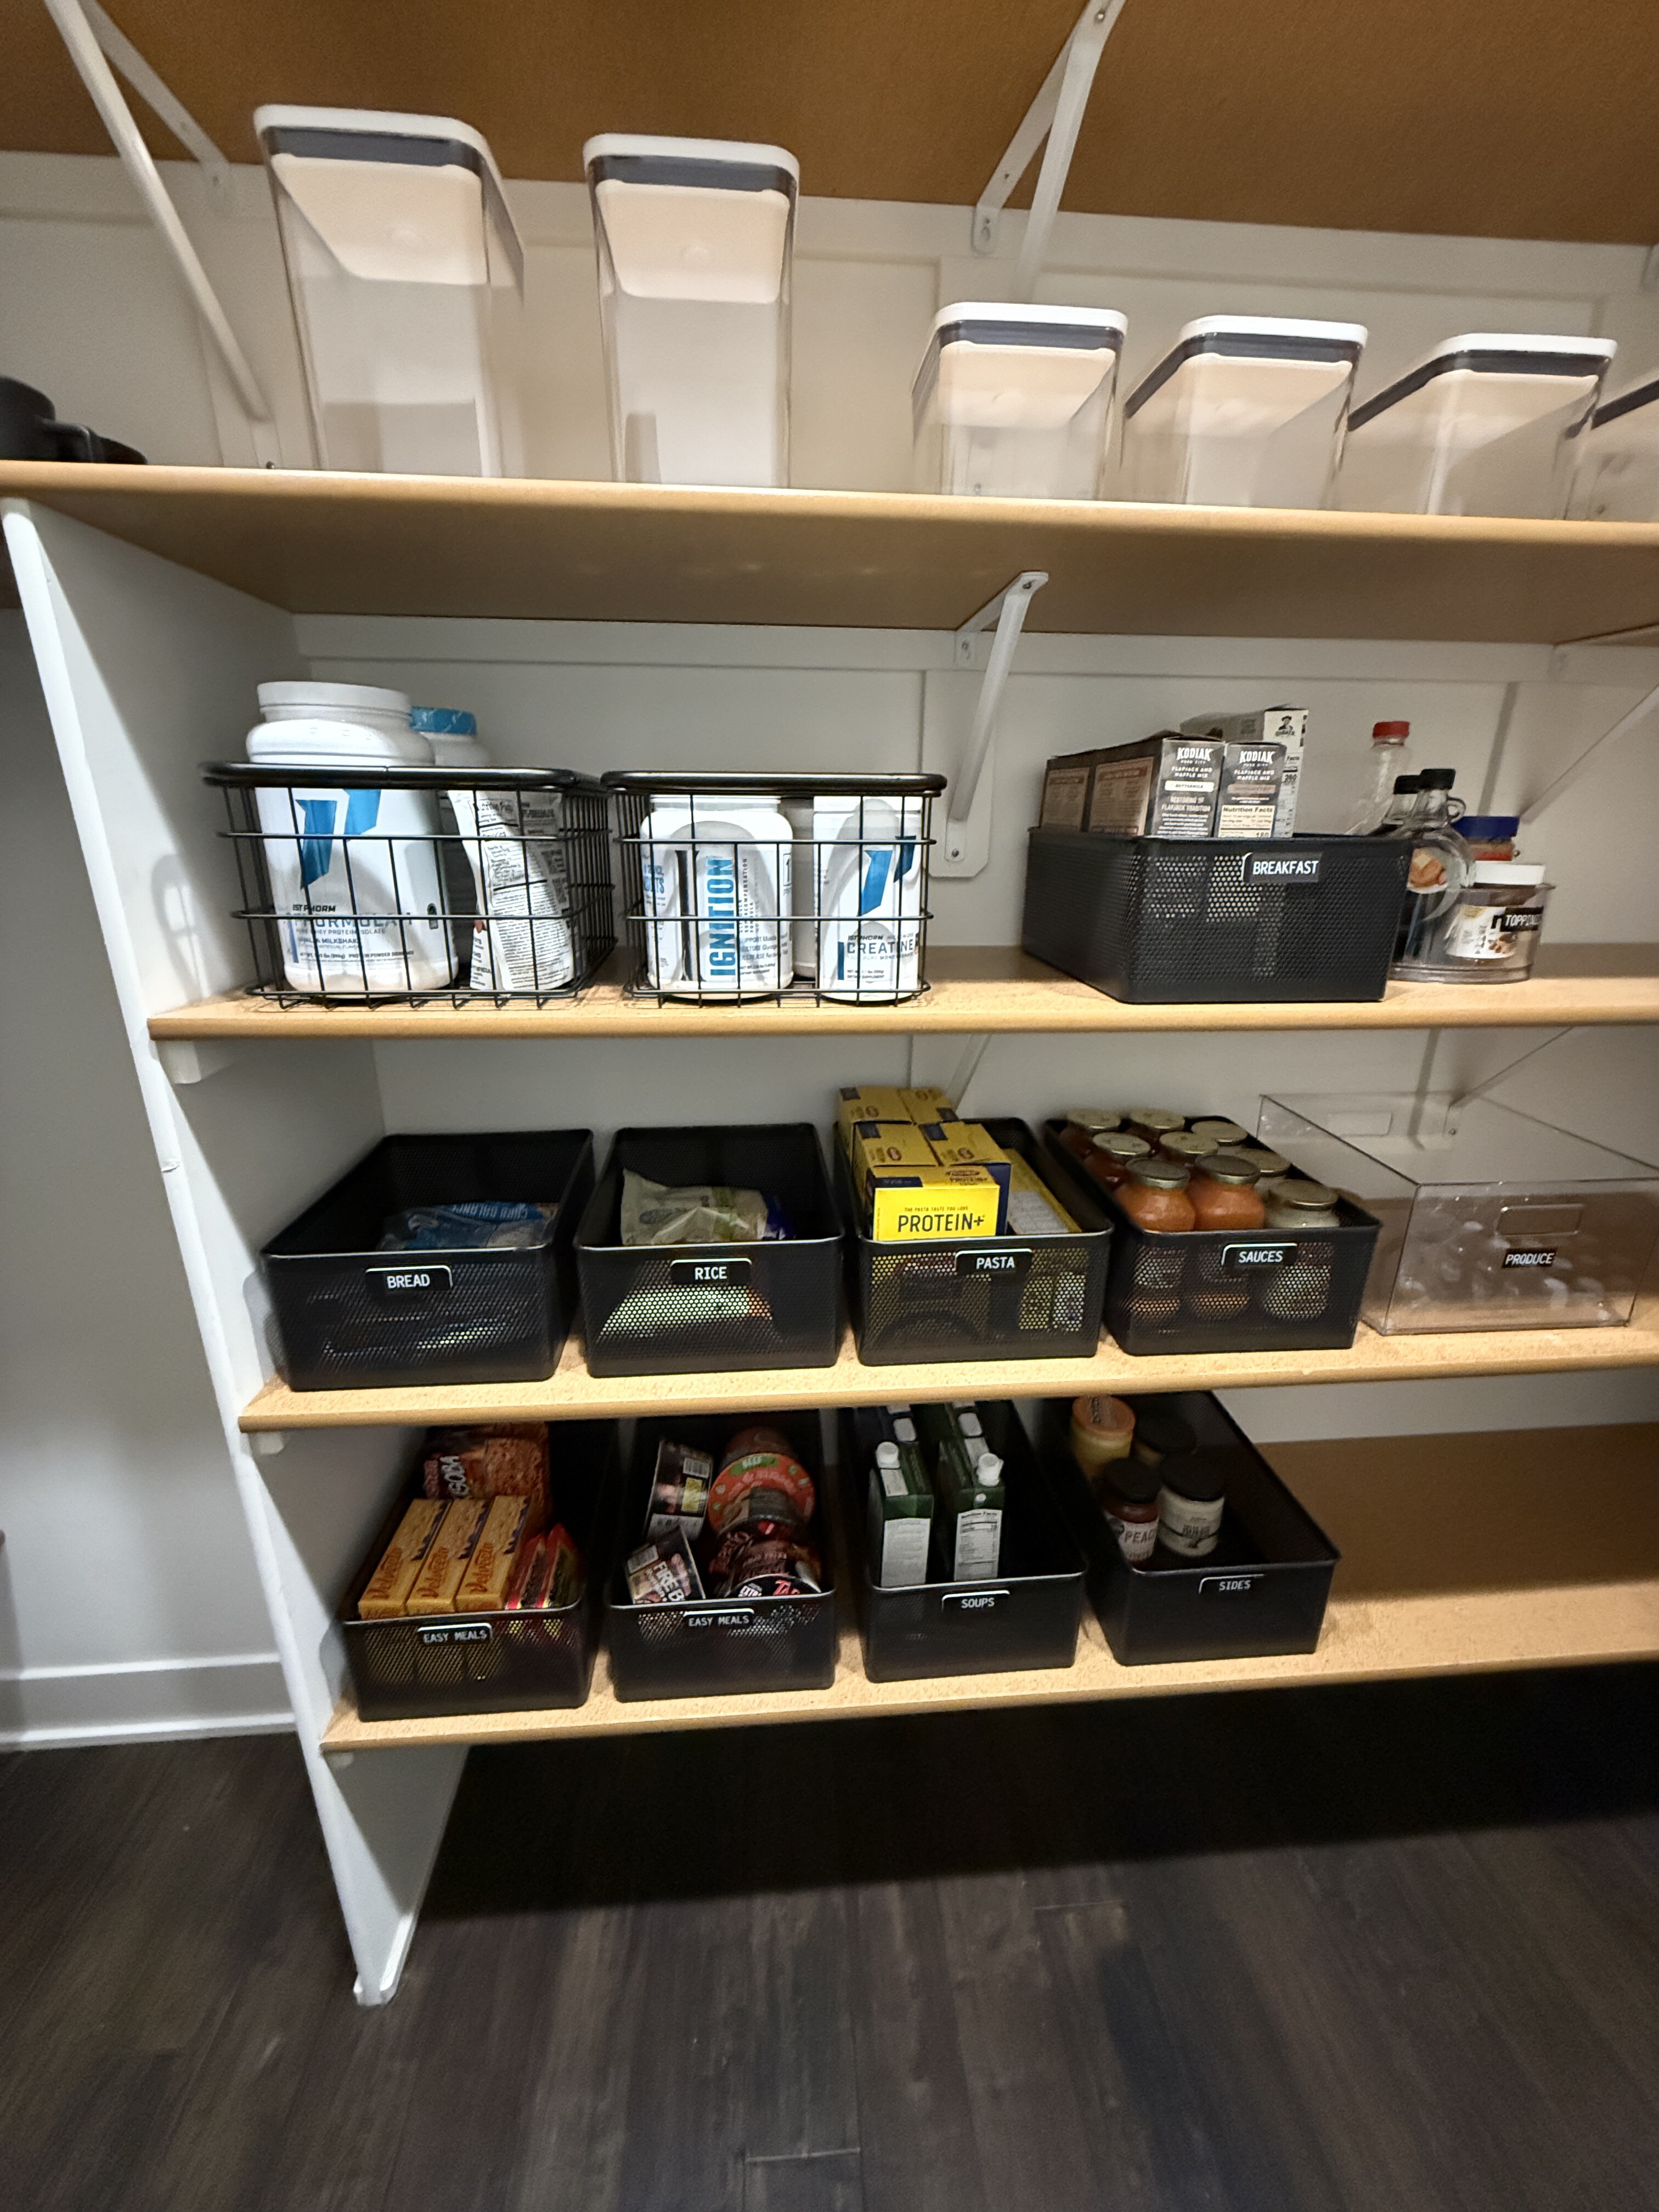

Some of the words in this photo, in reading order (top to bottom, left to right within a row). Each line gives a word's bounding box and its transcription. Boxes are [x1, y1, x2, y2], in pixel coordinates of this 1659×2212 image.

[1176, 747, 1213, 761] KODIAK
[1239, 751, 1276, 764] KODIAK
[1252, 860, 1319, 875] BREAKFAST
[707, 858, 736, 976] IGNITION
[846, 938, 914, 955] CREATNE
[976, 1256, 1015, 1269] PASTA
[1238, 1250, 1284, 1263] SAUCES
[1504, 1252, 1555, 1266] PRODUCE
[694, 1266, 727, 1280] RICE
[386, 1273, 431, 1289] BREAD
[1218, 1579, 1251, 1592] SIDES
[961, 1597, 995, 1609] SOUPS
[688, 1617, 713, 1627] EASY
[717, 1615, 750, 1626] MEALS
[422, 1632, 449, 1644] EASY
[454, 1629, 488, 1641] MEALS
